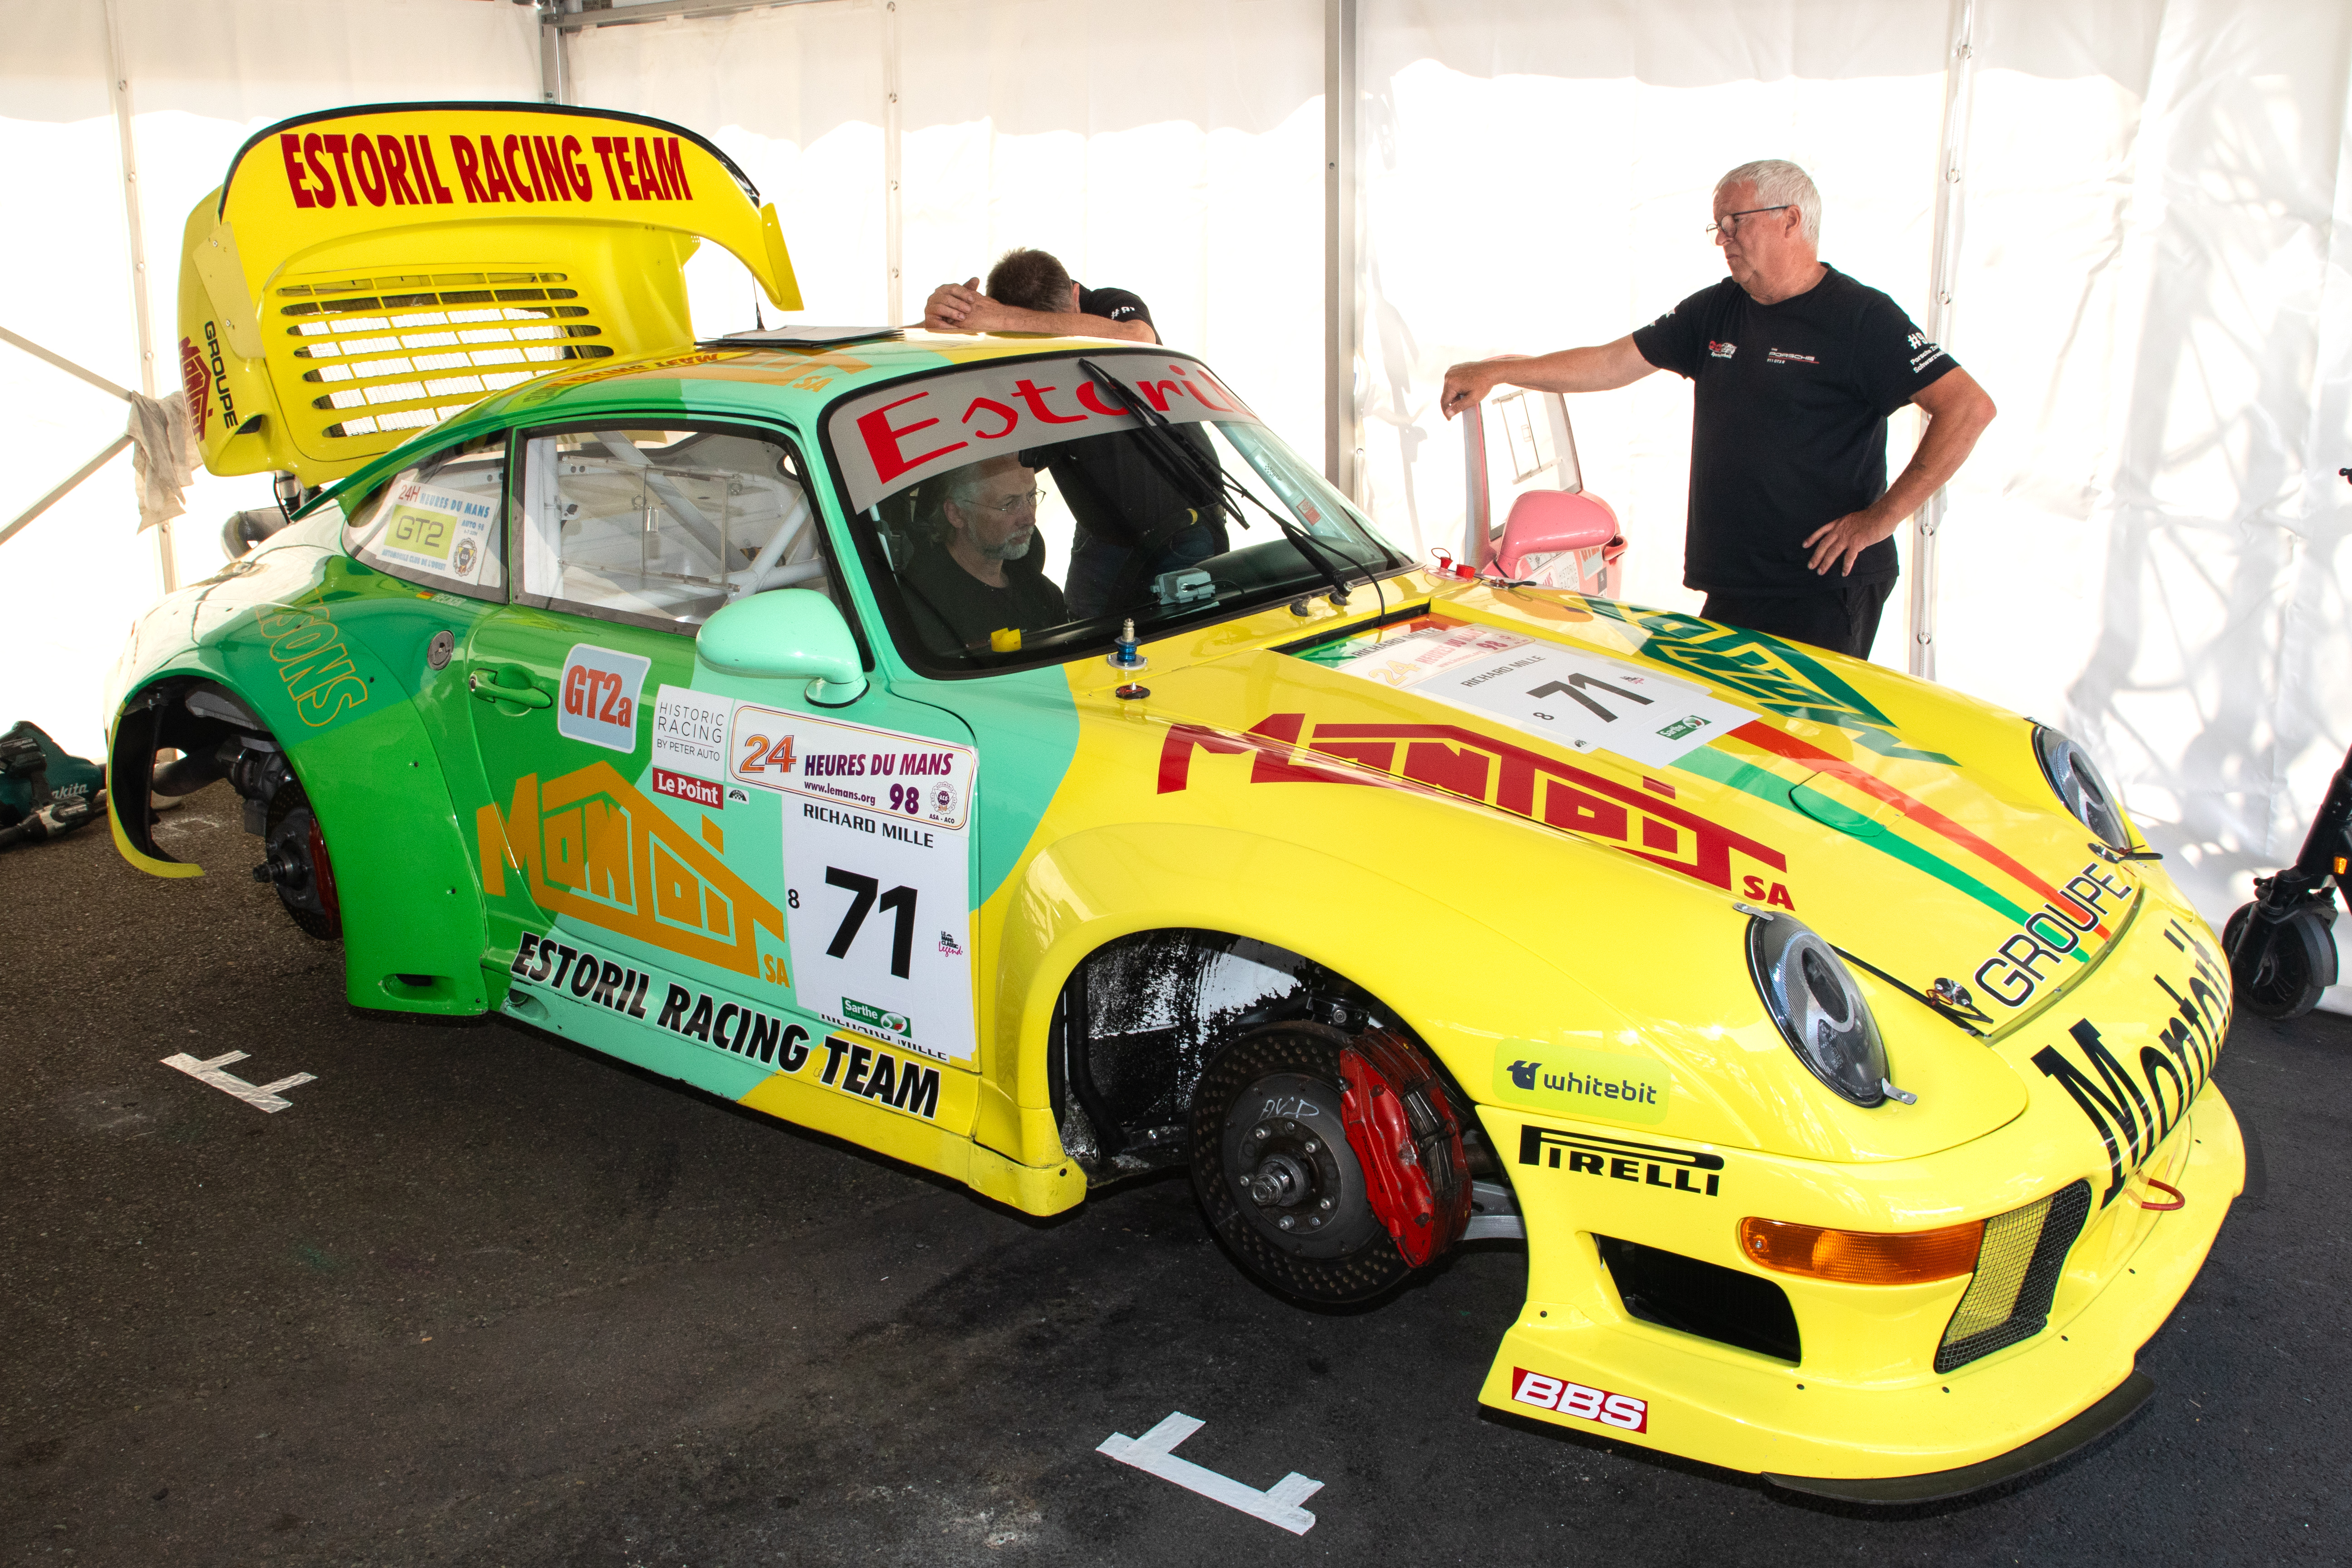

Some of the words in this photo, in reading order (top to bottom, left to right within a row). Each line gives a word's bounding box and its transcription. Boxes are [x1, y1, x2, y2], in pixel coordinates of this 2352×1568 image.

[280, 132, 453, 208] ESTORIL
[450, 134, 593, 203] RACING
[594, 136, 693, 201] TEAM
[1769, 352, 1815, 362] PORSCHE
[1910, 349, 1932, 365] Porsche
[205, 320, 239, 429] GROUPE
[856, 364, 1259, 484] Estoril
[398, 485, 421, 502] 24H
[420, 493, 449, 509] HEURES
[450, 500, 463, 512] DU
[464, 502, 490, 518] MANS
[396, 515, 444, 548] GT2
[1351, 637, 1408, 657] RICHARD
[1407, 627, 1442, 643] MILLE
[1443, 638, 1467, 648] DU
[1476, 640, 1509, 651] 98
[1368, 660, 1421, 686] 24
[1460, 666, 1514, 687] RICHARD
[1510, 655, 1547, 669] MILLE
[564, 665, 632, 728] GT2a
[1525, 672, 1655, 723] 71
[658, 716, 722, 743] RACING
[660, 702, 725, 726] HISTORIC
[1533, 712, 1555, 720] 8
[1660, 725, 1686, 736] Sarthe
[657, 739, 667, 749] BY
[669, 741, 695, 755] PETER
[697, 748, 720, 761] AUTO
[740, 735, 797, 774] 24
[804, 754, 867, 776] HEURES
[870, 754, 896, 776] DU
[899, 753, 954, 776] MANS
[51, 782, 89, 799] akita
[658, 773, 675, 793] Le
[677, 781, 718, 805] Point
[804, 781, 876, 806] www.lemans.org
[889, 783, 920, 815] 98
[804, 803, 875, 834] RICHARD
[882, 822, 934, 848] MILLE
[788, 887, 801, 910] 8
[1742, 874, 1796, 912] SA
[825, 865, 918, 980] 71
[1974, 862, 2132, 1008] GROUPE
[939, 941, 962, 957] Legend
[763, 953, 790, 988] SA
[845, 1000, 878, 1019] Sarthe
[510, 931, 650, 1020] ESTORIL
[657, 982, 810, 1074] RACING
[819, 1034, 942, 1121] TEAM
[2030, 917, 2231, 1210] Montoit
[1544, 1072, 1657, 1105] whitebit
[1362, 1136, 1385, 1193] PORSCHE
[1519, 1124, 1725, 1196] PIRELLI
[1514, 1372, 1646, 1430] BBS
